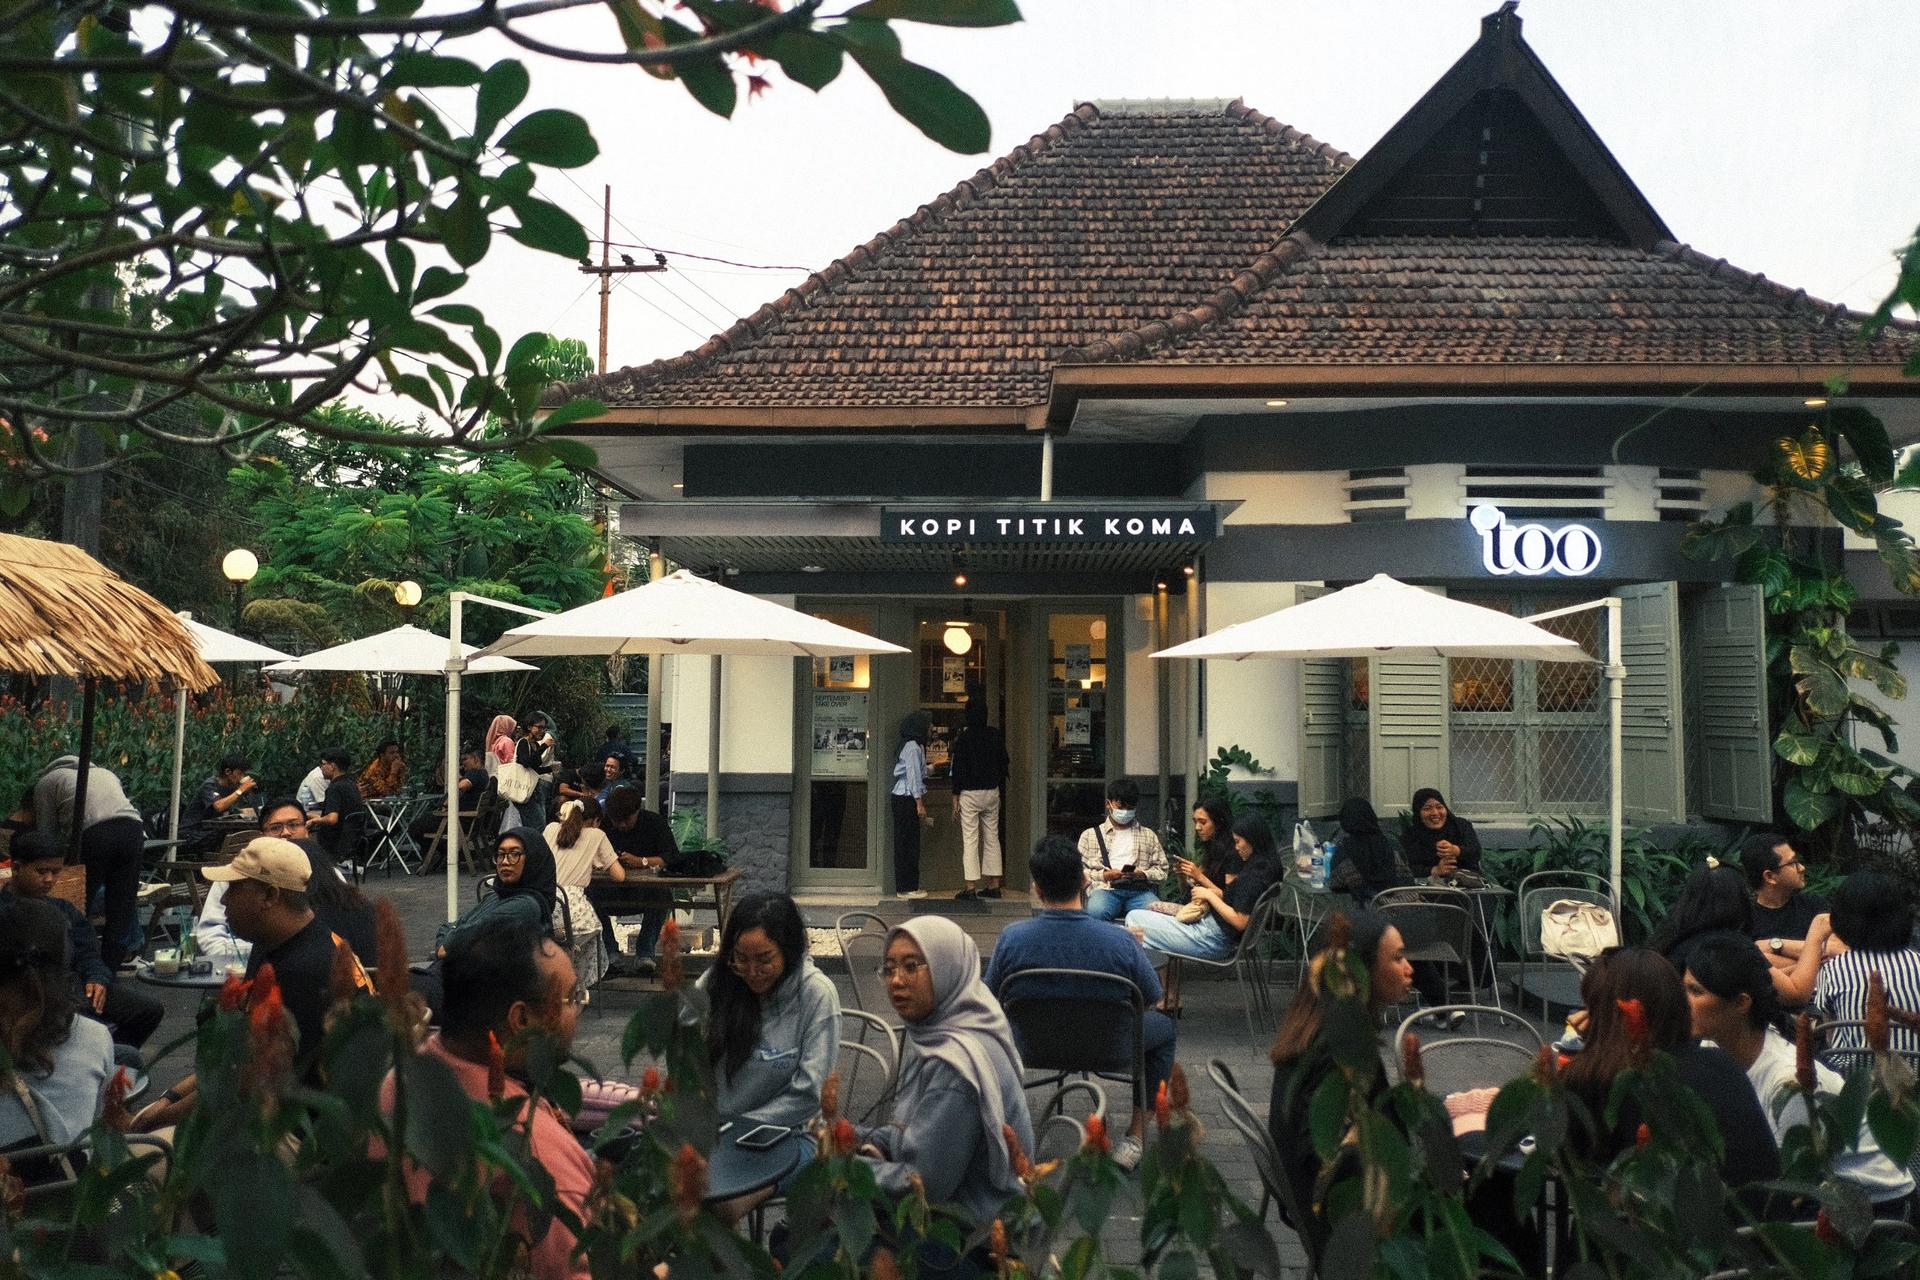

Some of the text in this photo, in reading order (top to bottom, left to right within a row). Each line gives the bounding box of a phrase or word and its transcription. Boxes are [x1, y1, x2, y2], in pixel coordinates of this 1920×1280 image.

[900, 518, 1196, 535] KOPI TITIK KOMA
